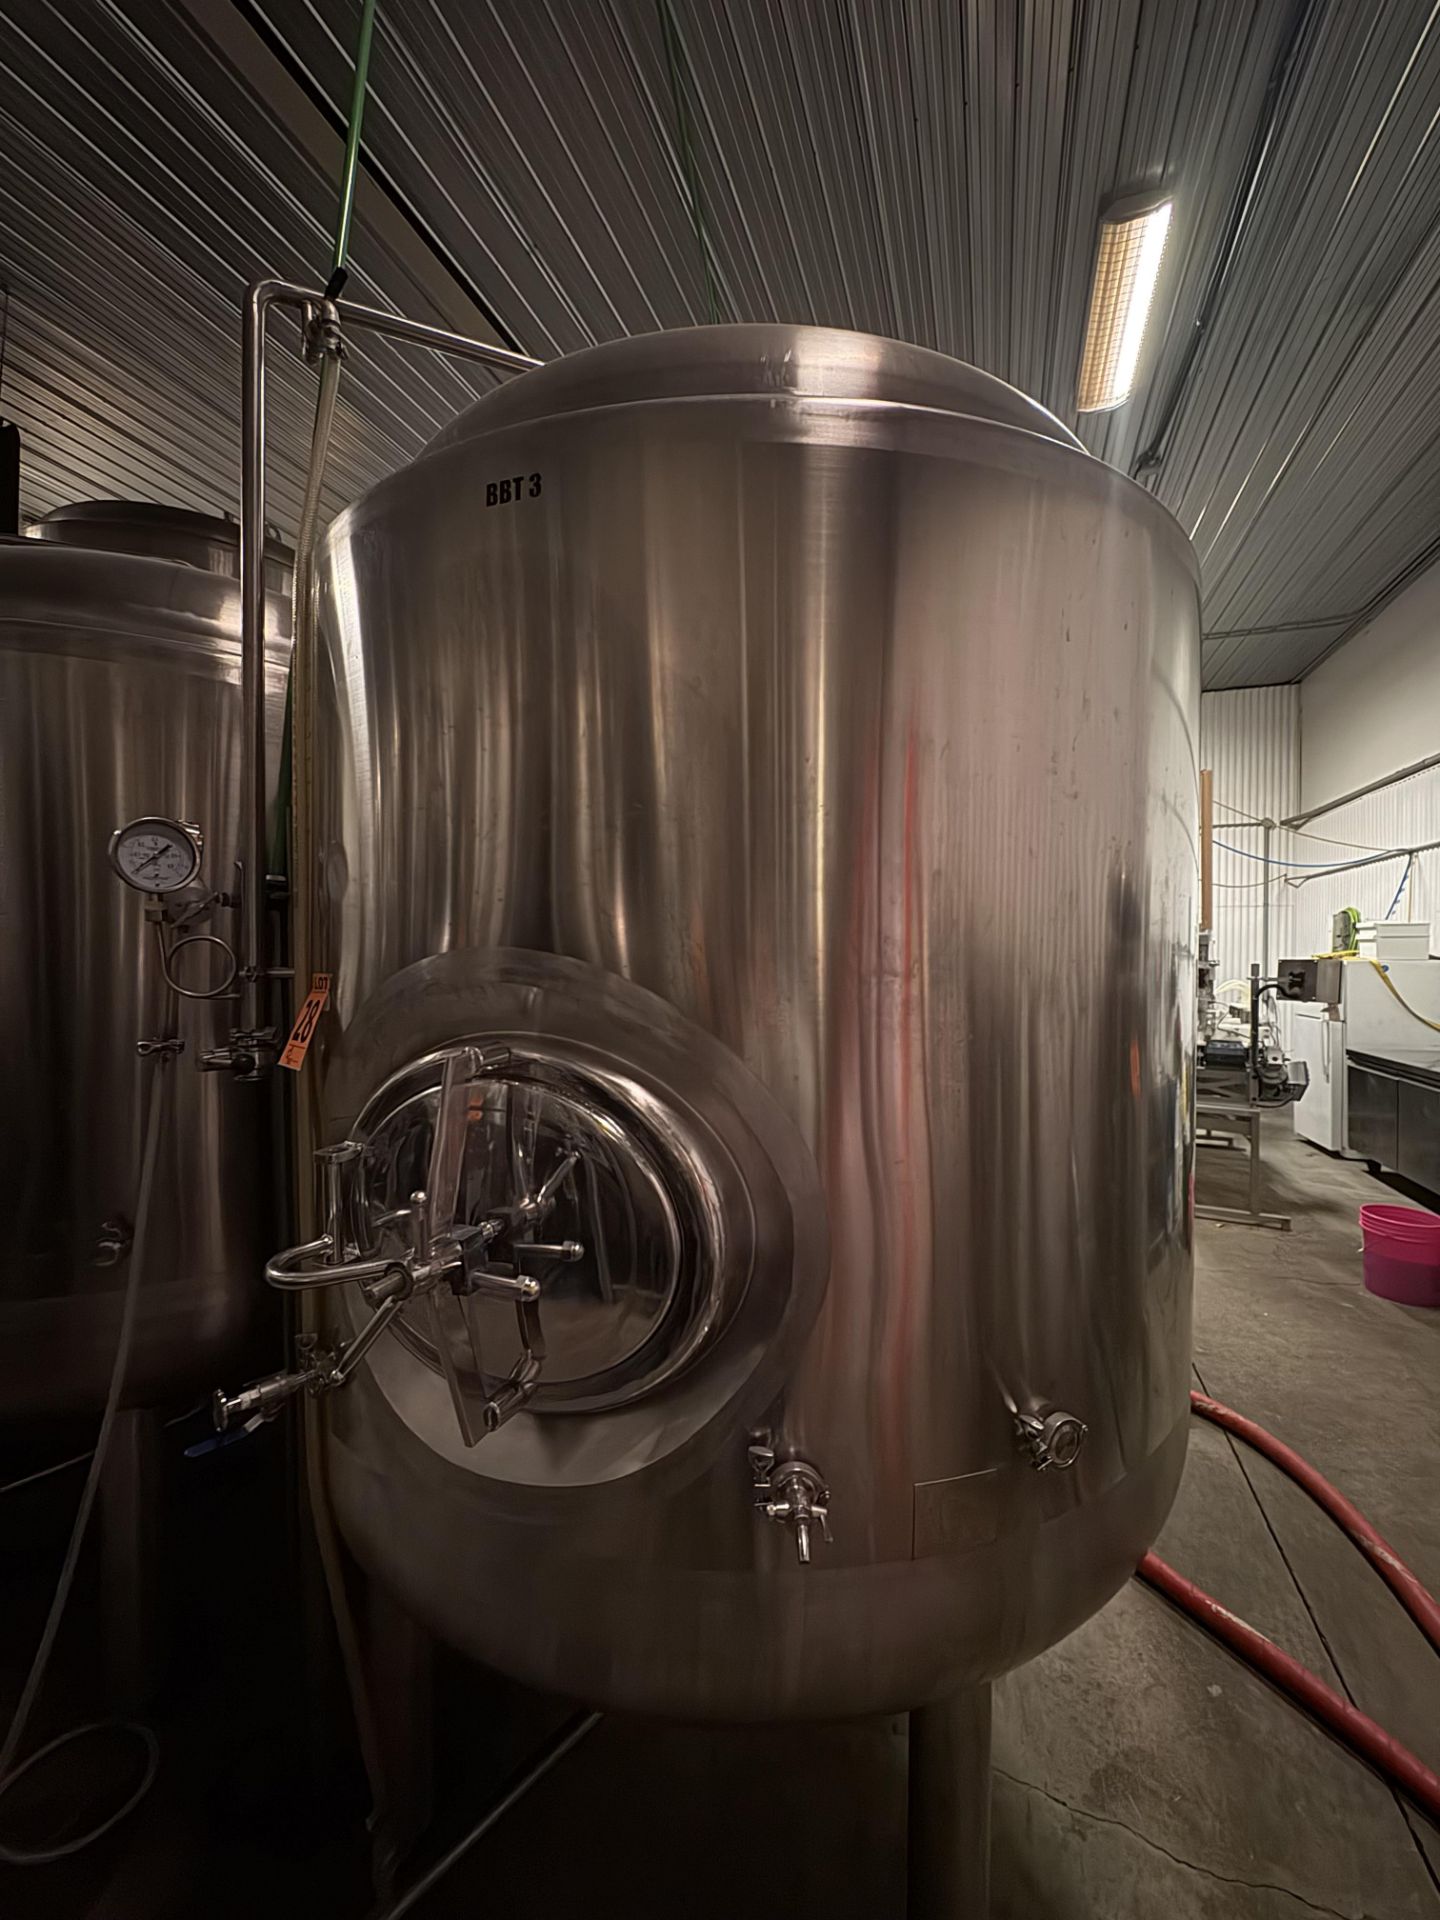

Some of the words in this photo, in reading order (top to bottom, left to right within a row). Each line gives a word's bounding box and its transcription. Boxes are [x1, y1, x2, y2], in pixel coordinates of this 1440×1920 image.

[486, 476, 524, 507] BBT
[529, 472, 542, 498] 3
[314, 976, 329, 990] LOT
[292, 999, 321, 1043] 28
